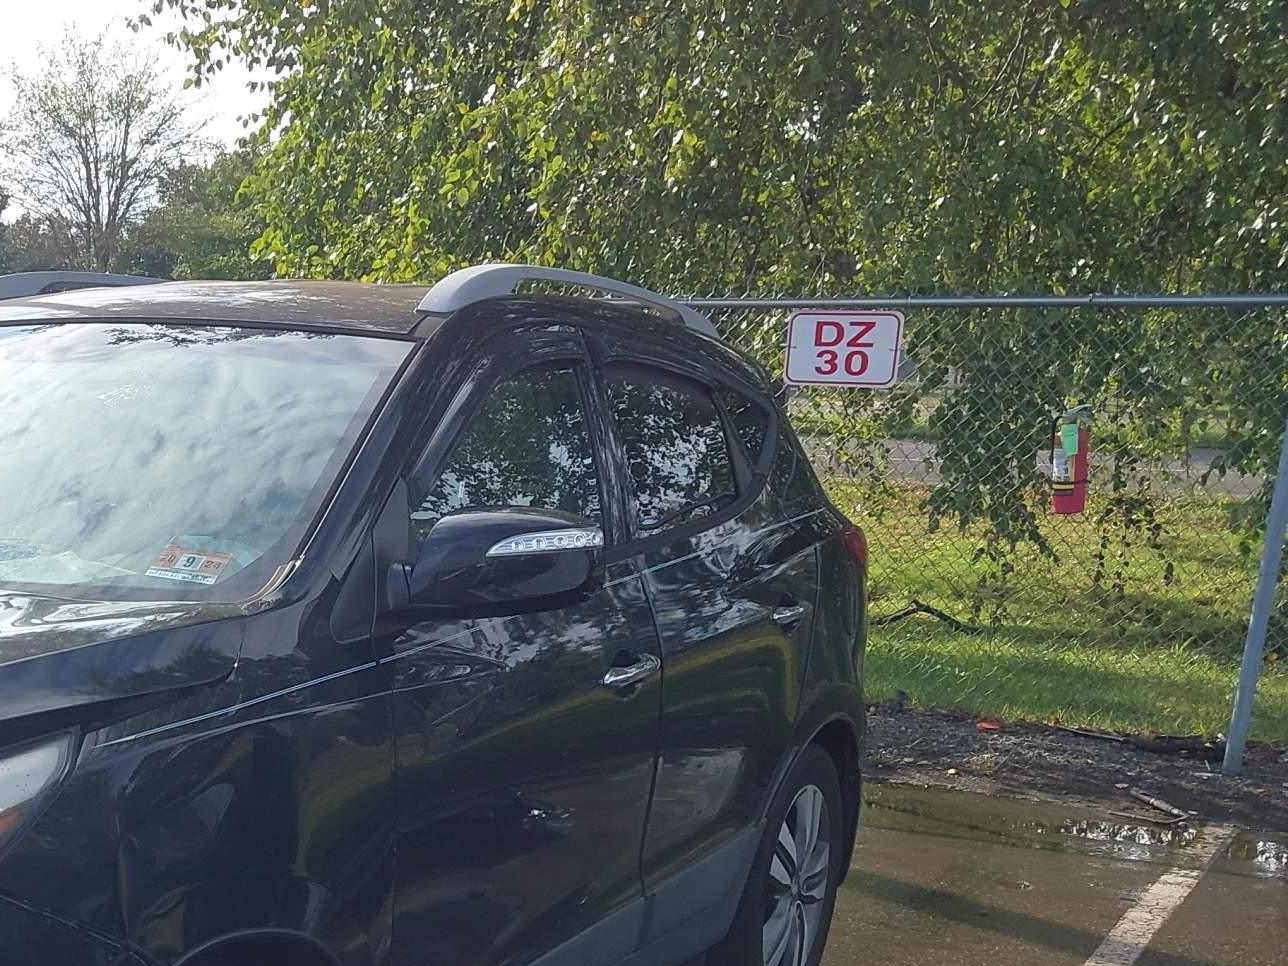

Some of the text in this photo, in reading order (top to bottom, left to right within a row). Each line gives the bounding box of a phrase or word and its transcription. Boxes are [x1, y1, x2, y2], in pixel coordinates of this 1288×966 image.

[814, 321, 877, 347] DZ
[814, 350, 869, 376] 30
[183, 556, 196, 568] 9
